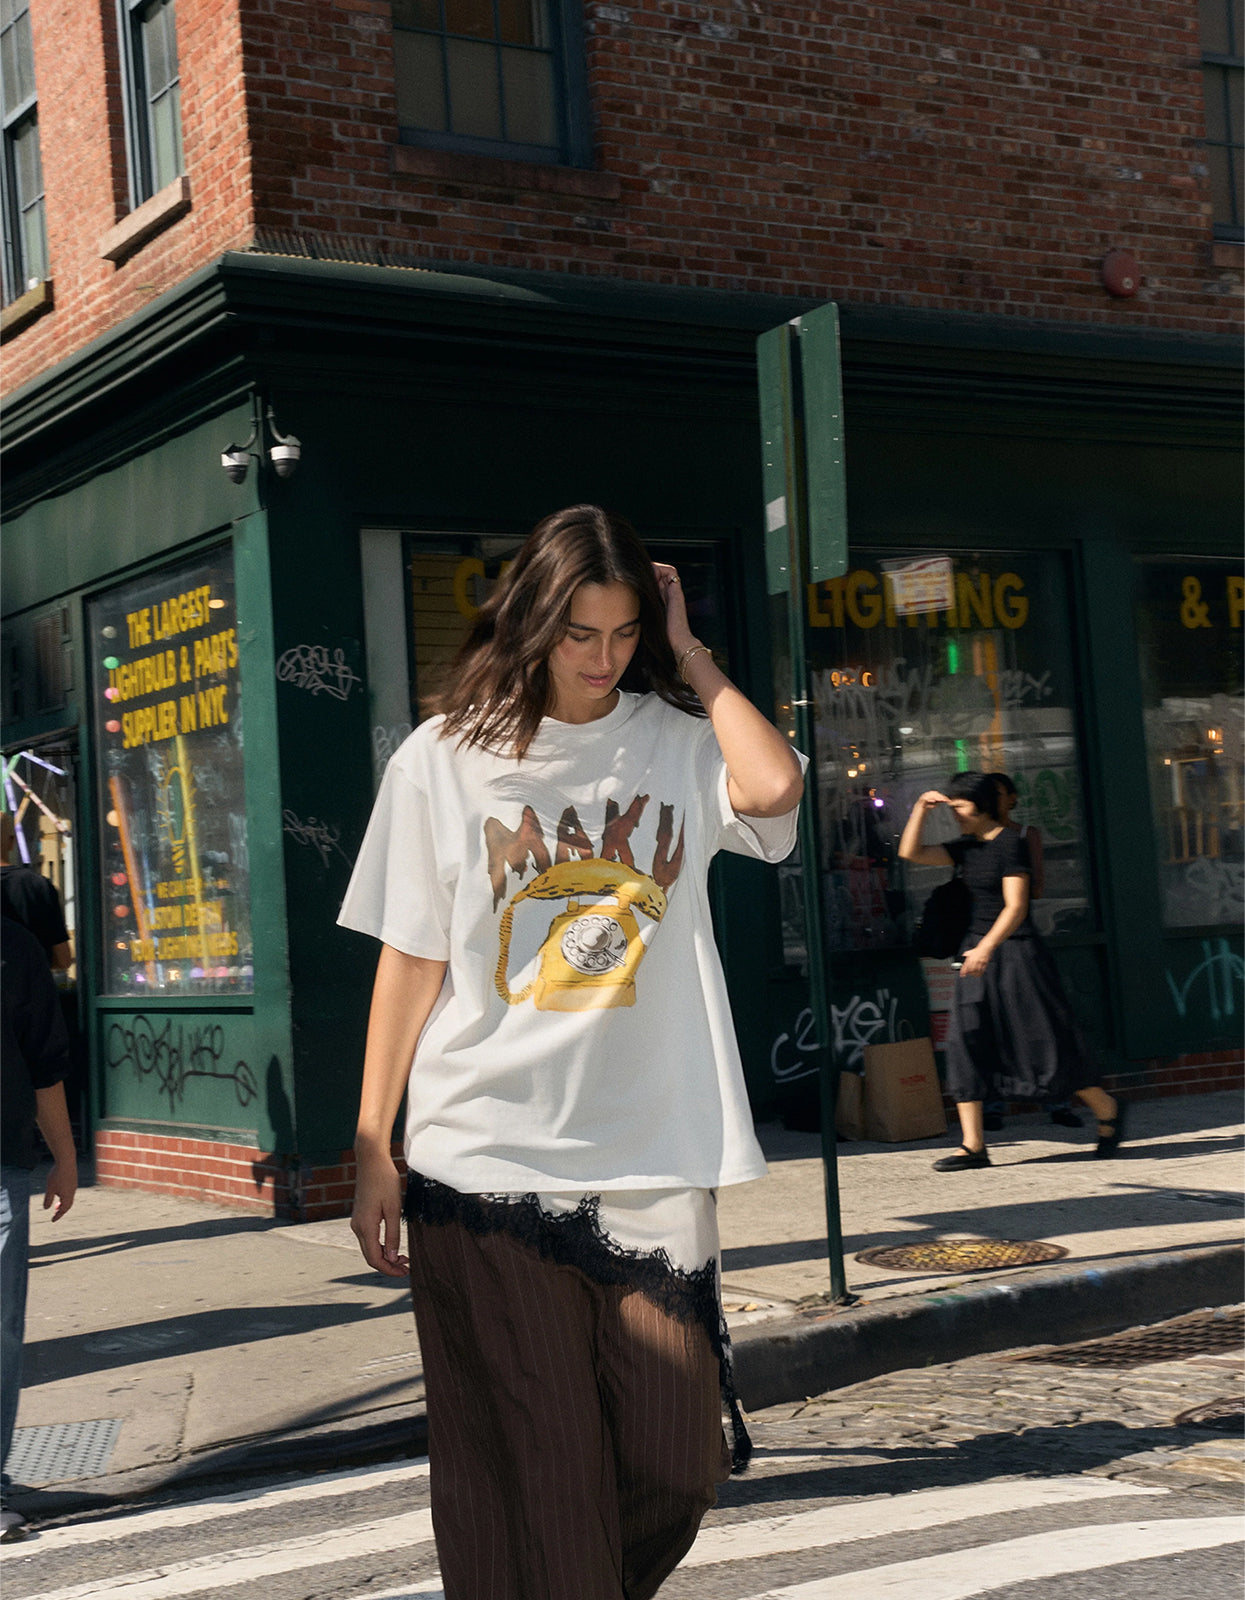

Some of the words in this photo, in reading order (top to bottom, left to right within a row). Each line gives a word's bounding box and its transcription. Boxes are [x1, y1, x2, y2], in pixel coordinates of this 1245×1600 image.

[126, 607, 152, 649] THE
[153, 585, 210, 640] LARGEST
[1180, 575, 1213, 630] &
[109, 650, 176, 703] LIGHTBULB
[180, 646, 192, 682] &
[194, 628, 238, 677] PARTS
[121, 700, 178, 749] SUPPLIER
[179, 693, 197, 734] IN
[198, 684, 229, 729] NYC
[484, 793, 686, 915] MAKU
